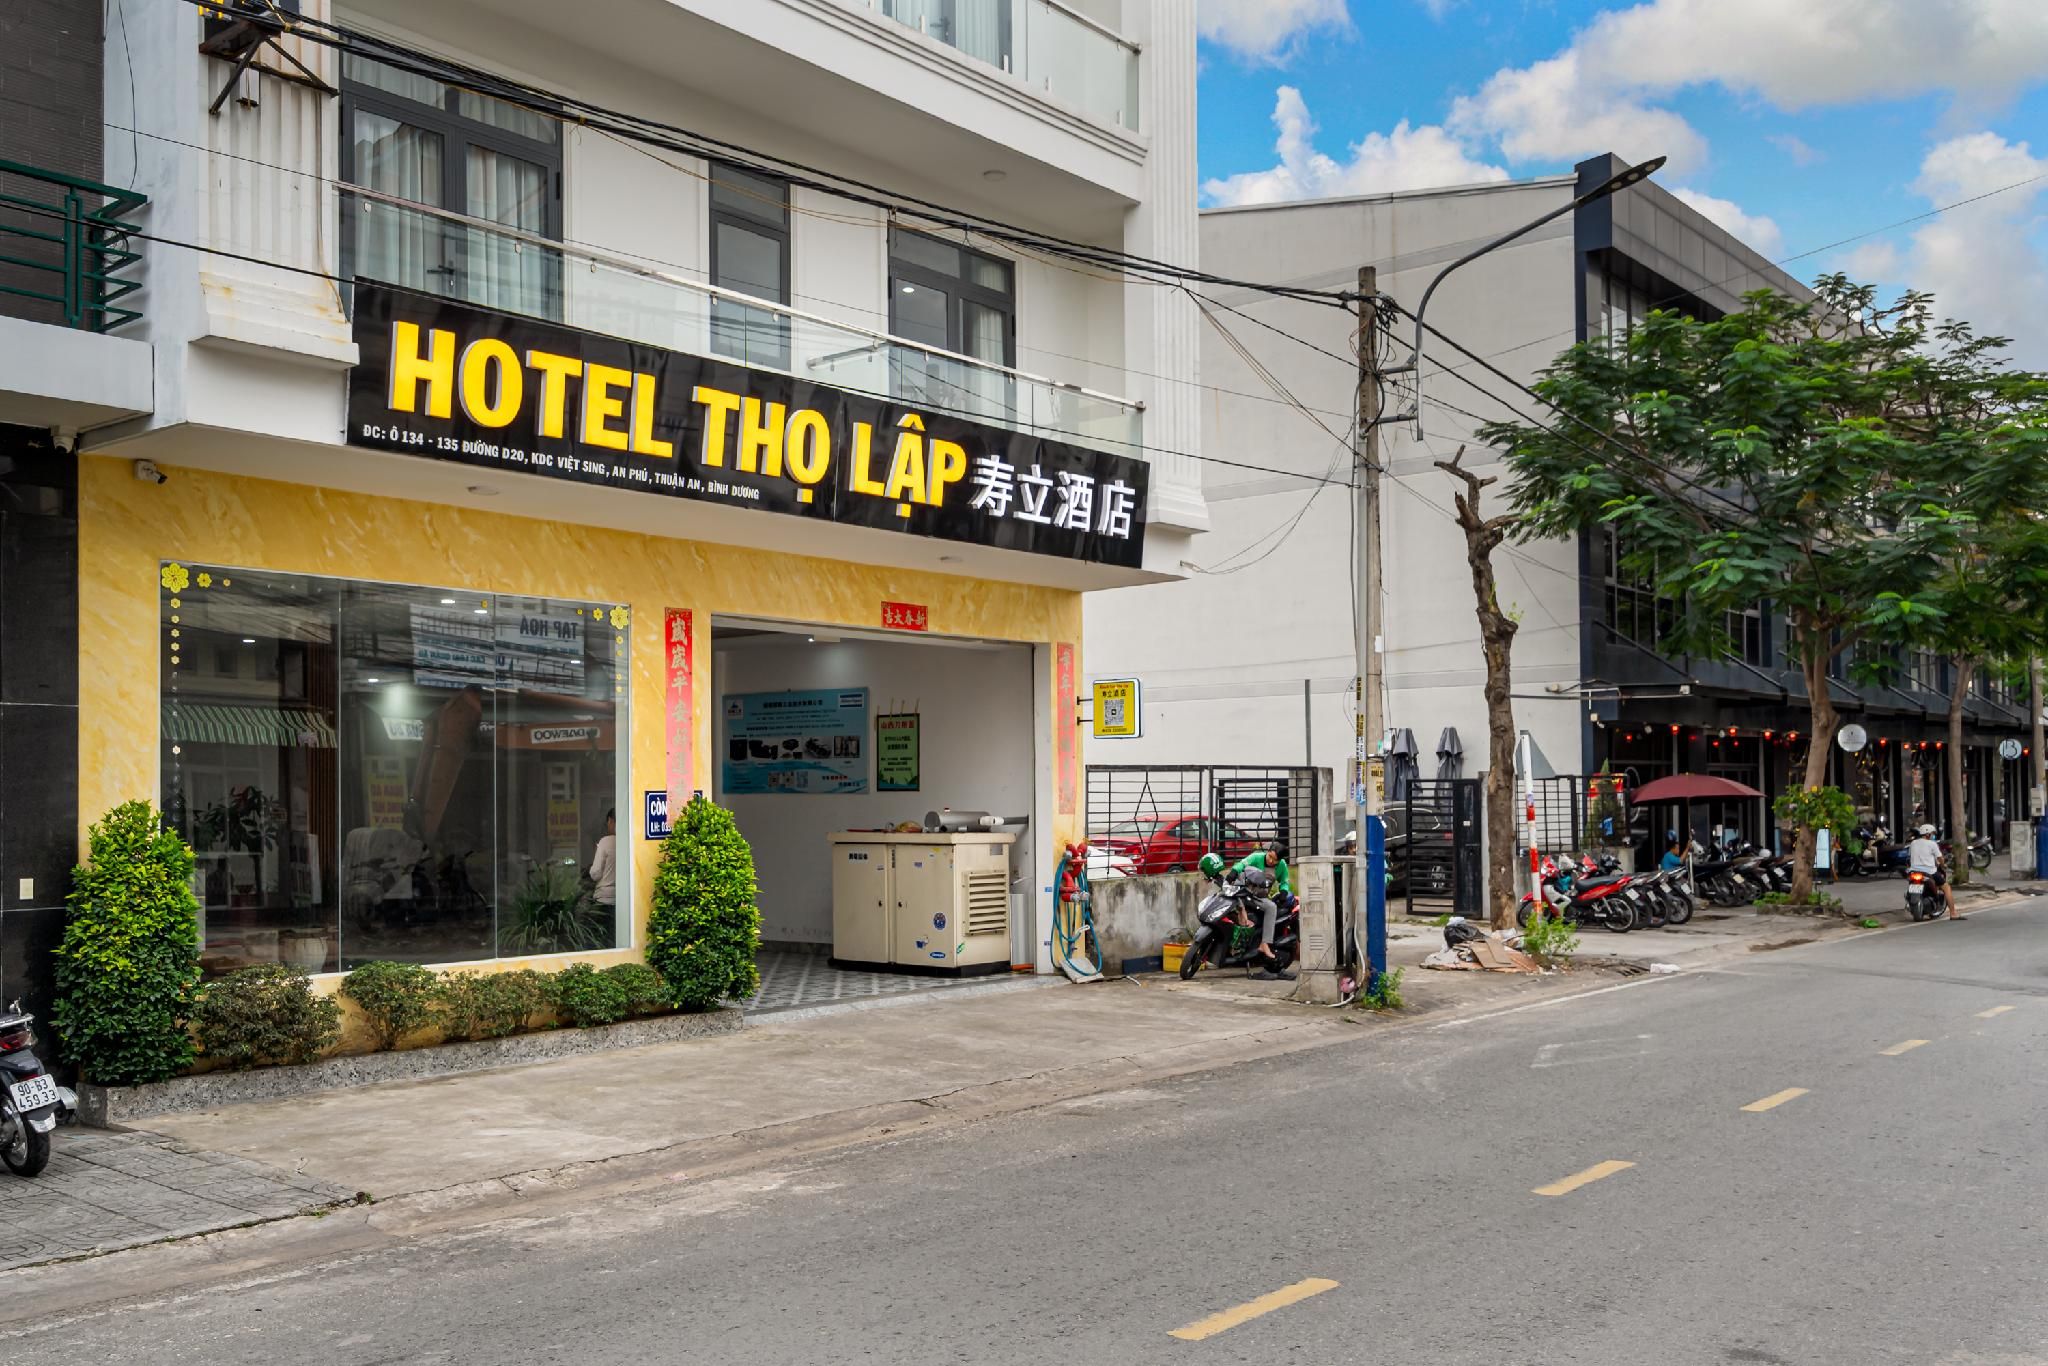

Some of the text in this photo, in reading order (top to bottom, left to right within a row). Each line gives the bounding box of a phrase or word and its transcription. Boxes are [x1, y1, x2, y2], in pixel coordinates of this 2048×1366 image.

[388, 320, 967, 518] HOTEL THỌ LẬP
[363, 424, 386, 439] ĐC:
[390, 425, 399, 441] Ô
[402, 431, 424, 445] 134
[437, 437, 458, 450] 135
[463, 439, 499, 458] ĐƯỜNG
[502, 448, 529, 464] D20,
[532, 452, 553, 467] KDC
[557, 455, 580, 473] VIỆT
[582, 463, 610, 478] SING,
[612, 467, 626, 479] AN
[629, 467, 652, 485] PHÚ,
[655, 472, 685, 489] THUẬN
[687, 479, 705, 493] AN,
[708, 479, 728, 495] BÌNH
[732, 485, 760, 500] DƯƠNG
[968, 454, 1136, 539] 寿立酒店
[17, 1078, 49, 1097] 90-B3
[19, 1089, 57, 1110] 459.33
